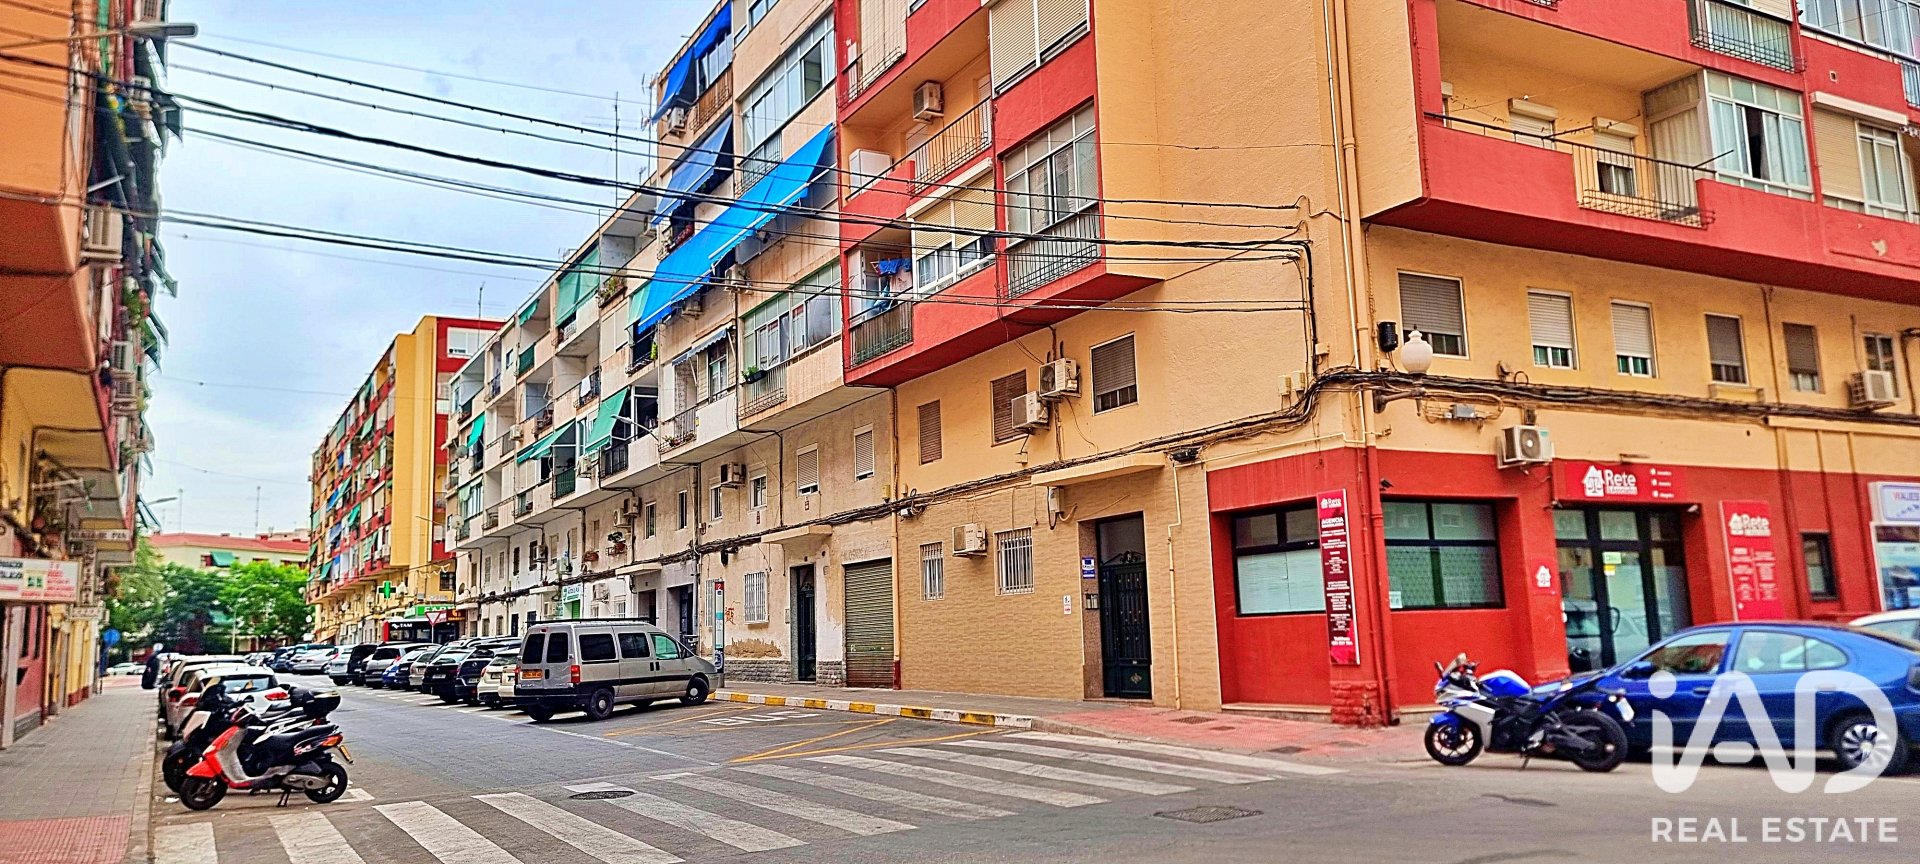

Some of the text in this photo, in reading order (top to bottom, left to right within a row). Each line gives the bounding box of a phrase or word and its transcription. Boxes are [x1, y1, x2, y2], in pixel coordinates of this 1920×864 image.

[1604, 469, 1637, 487] Rete
[1742, 514, 1769, 530] Rete
[697, 711, 822, 726] BUS
